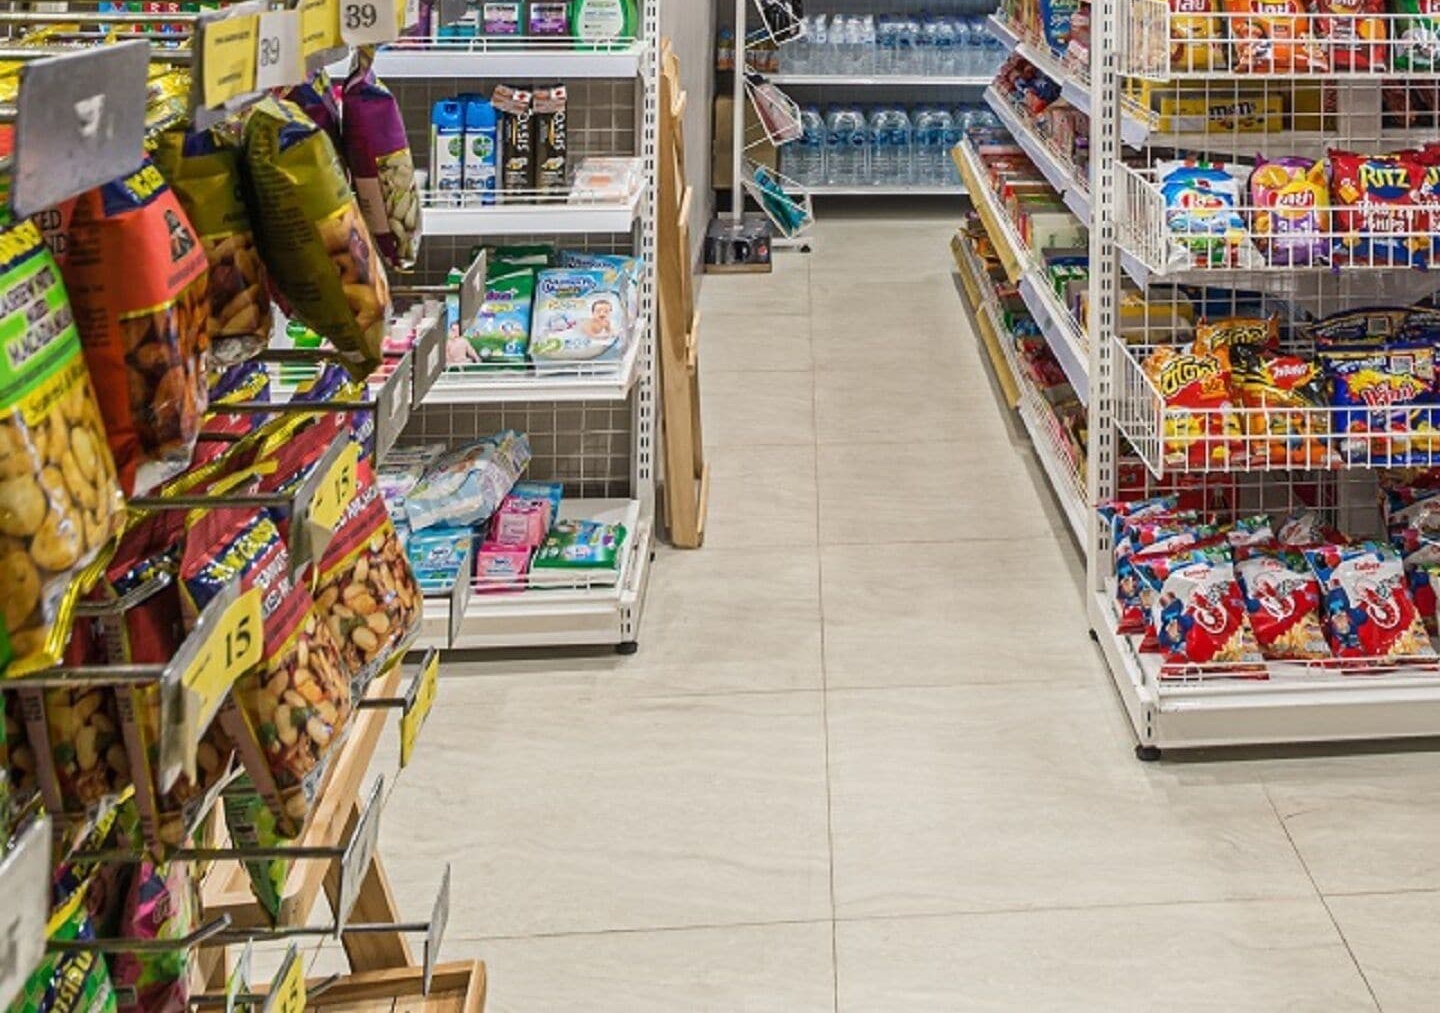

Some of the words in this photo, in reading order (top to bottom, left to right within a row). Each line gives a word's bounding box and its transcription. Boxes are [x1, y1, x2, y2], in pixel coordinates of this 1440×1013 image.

[344, 2, 378, 31] 39
[260, 36, 281, 68] 39
[1360, 165, 1410, 187] RITZ
[334, 464, 352, 507] 15
[223, 614, 252, 667] 15
